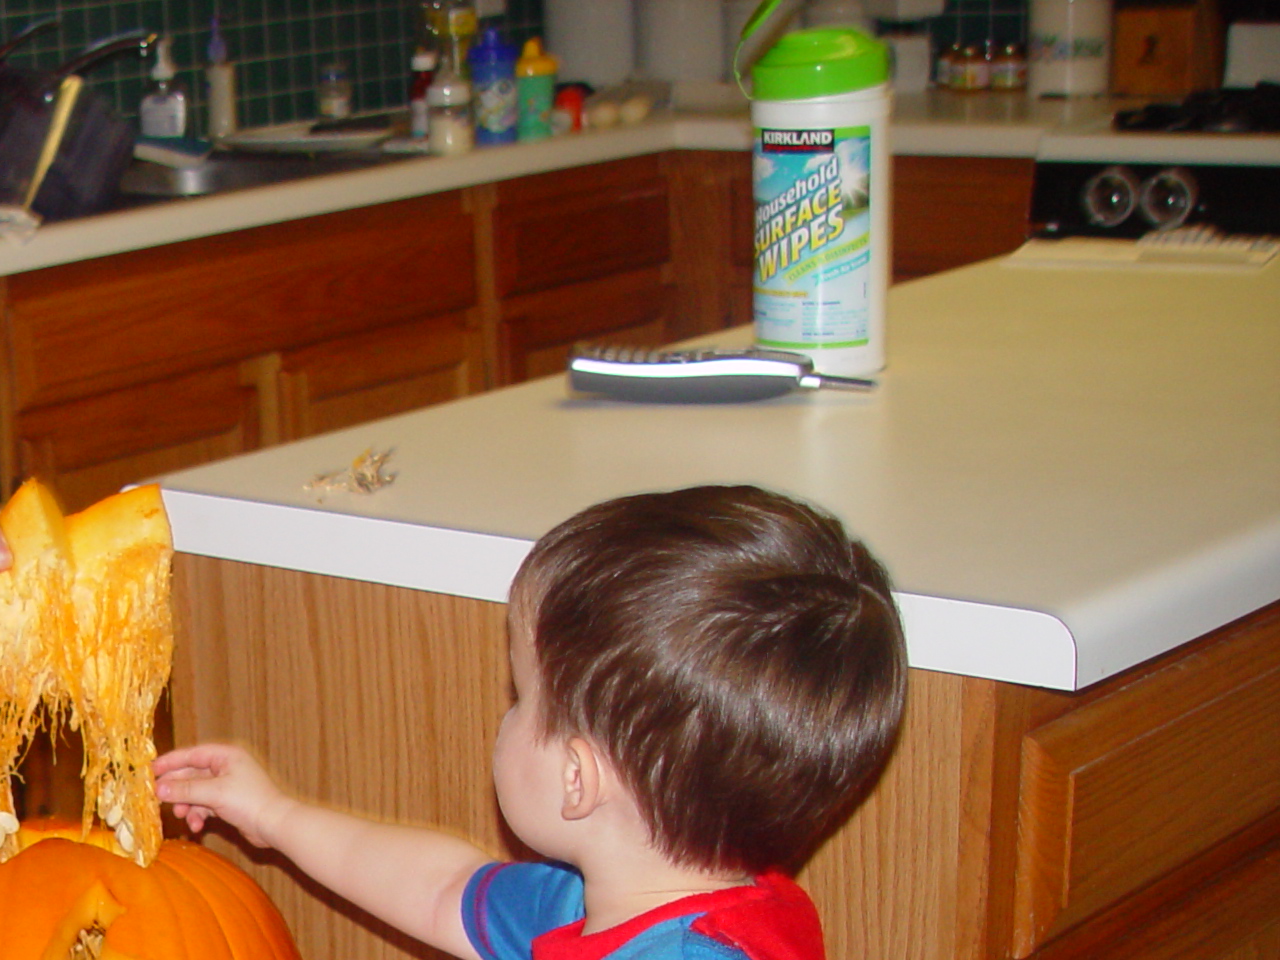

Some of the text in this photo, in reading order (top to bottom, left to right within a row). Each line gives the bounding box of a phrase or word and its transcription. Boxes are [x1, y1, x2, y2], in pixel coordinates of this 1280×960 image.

[764, 131, 833, 146] KIRKLAND
[754, 179, 842, 258] SURFACE
[755, 157, 839, 226] Household
[758, 204, 844, 283] WIPES
